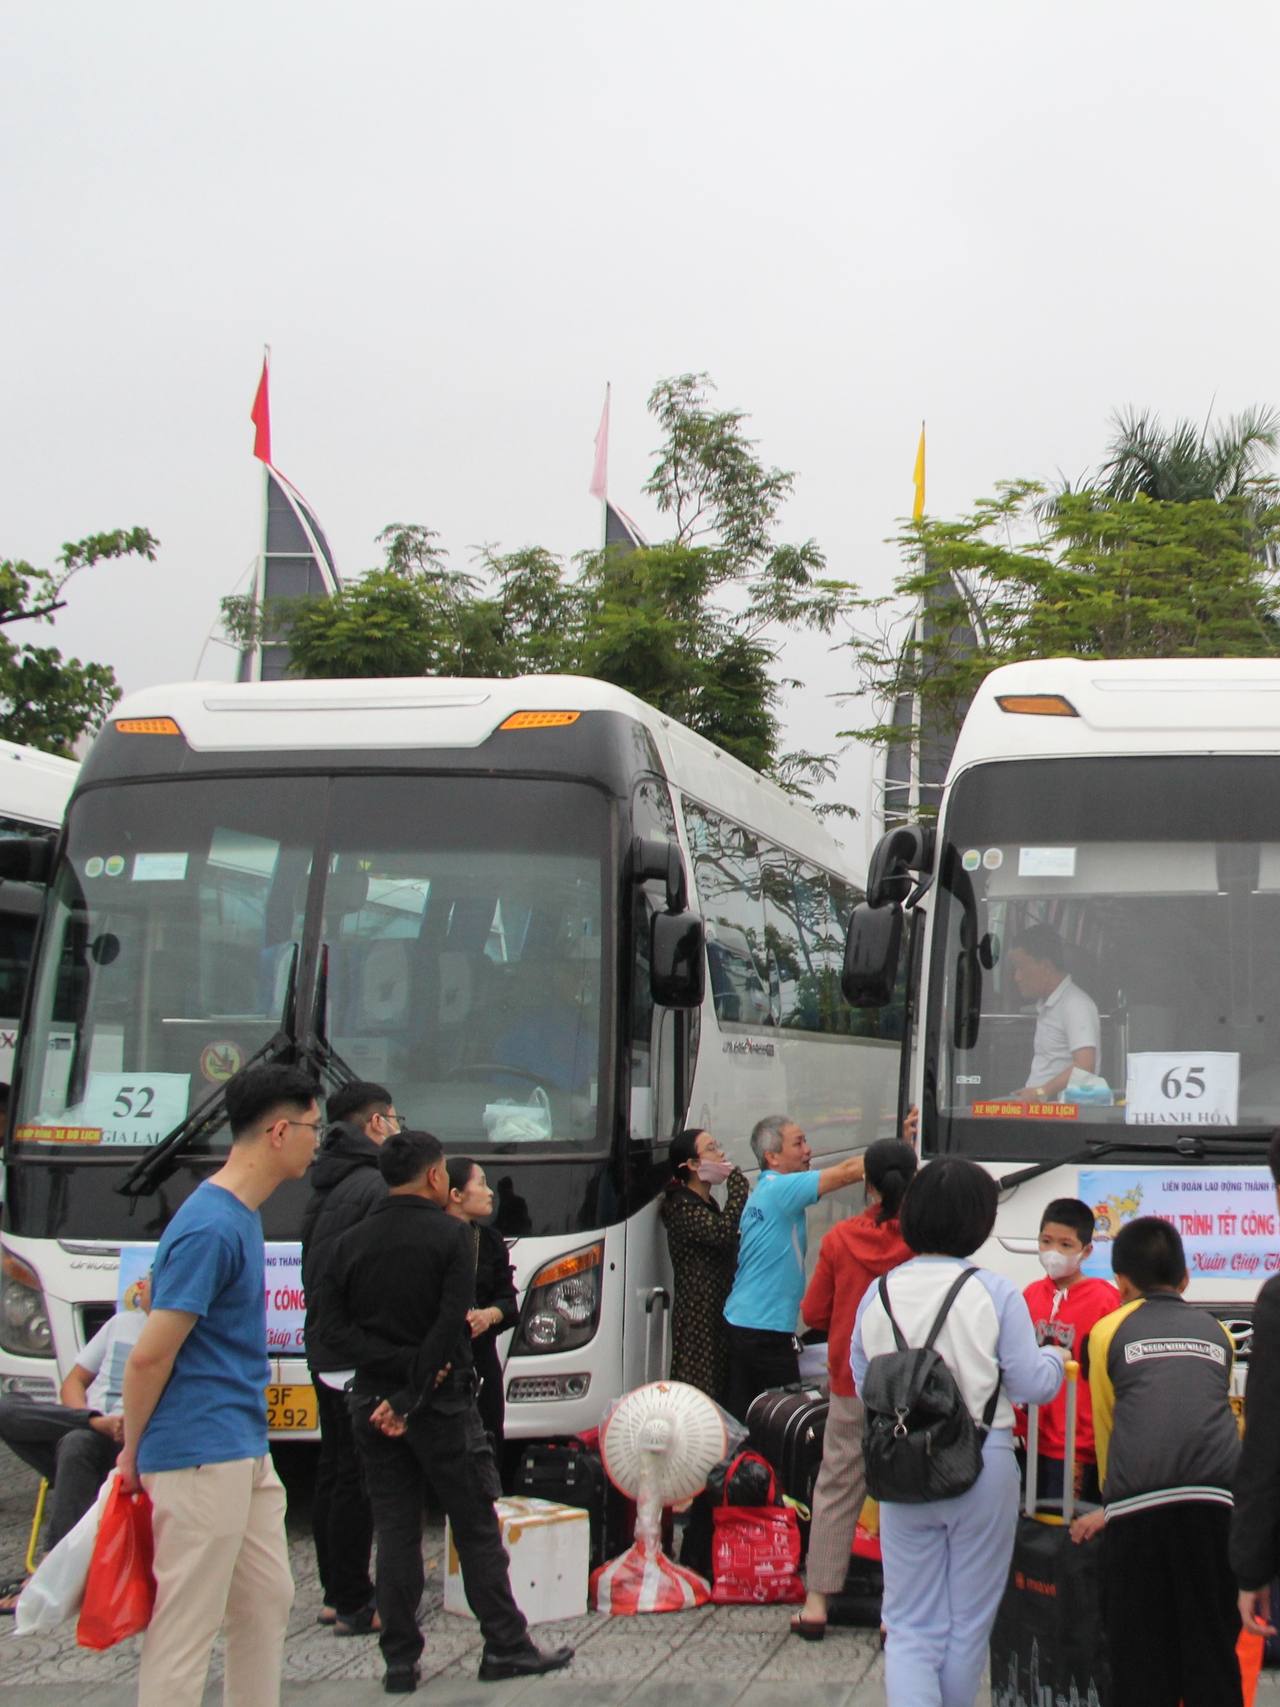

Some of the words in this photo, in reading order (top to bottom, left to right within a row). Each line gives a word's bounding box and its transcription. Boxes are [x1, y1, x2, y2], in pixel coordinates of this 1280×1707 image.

[1161, 1066, 1206, 1099] 65
[113, 1086, 156, 1118] 52
[974, 1104, 984, 1115] XE
[1029, 1104, 1040, 1115] XE
[1042, 1104, 1054, 1115] DU
[1132, 1111, 1192, 1124] THANH
[1198, 1108, 1231, 1125] HÓA
[101, 1130, 127, 1144] GIA
[133, 1131, 160, 1144] LAI
[1205, 1181, 1219, 1191] LAO
[1179, 1209, 1213, 1235] TRÌNH
[1217, 1206, 1237, 1235] TẾT
[1241, 1210, 1275, 1236] CÔNG
[1191, 1252, 1226, 1271] Xuân
[1230, 1252, 1260, 1273] Giáp
[274, 1284, 307, 1311] CÔNG
[269, 1388, 292, 1405] 3F
[268, 1409, 307, 1427] 2.92
